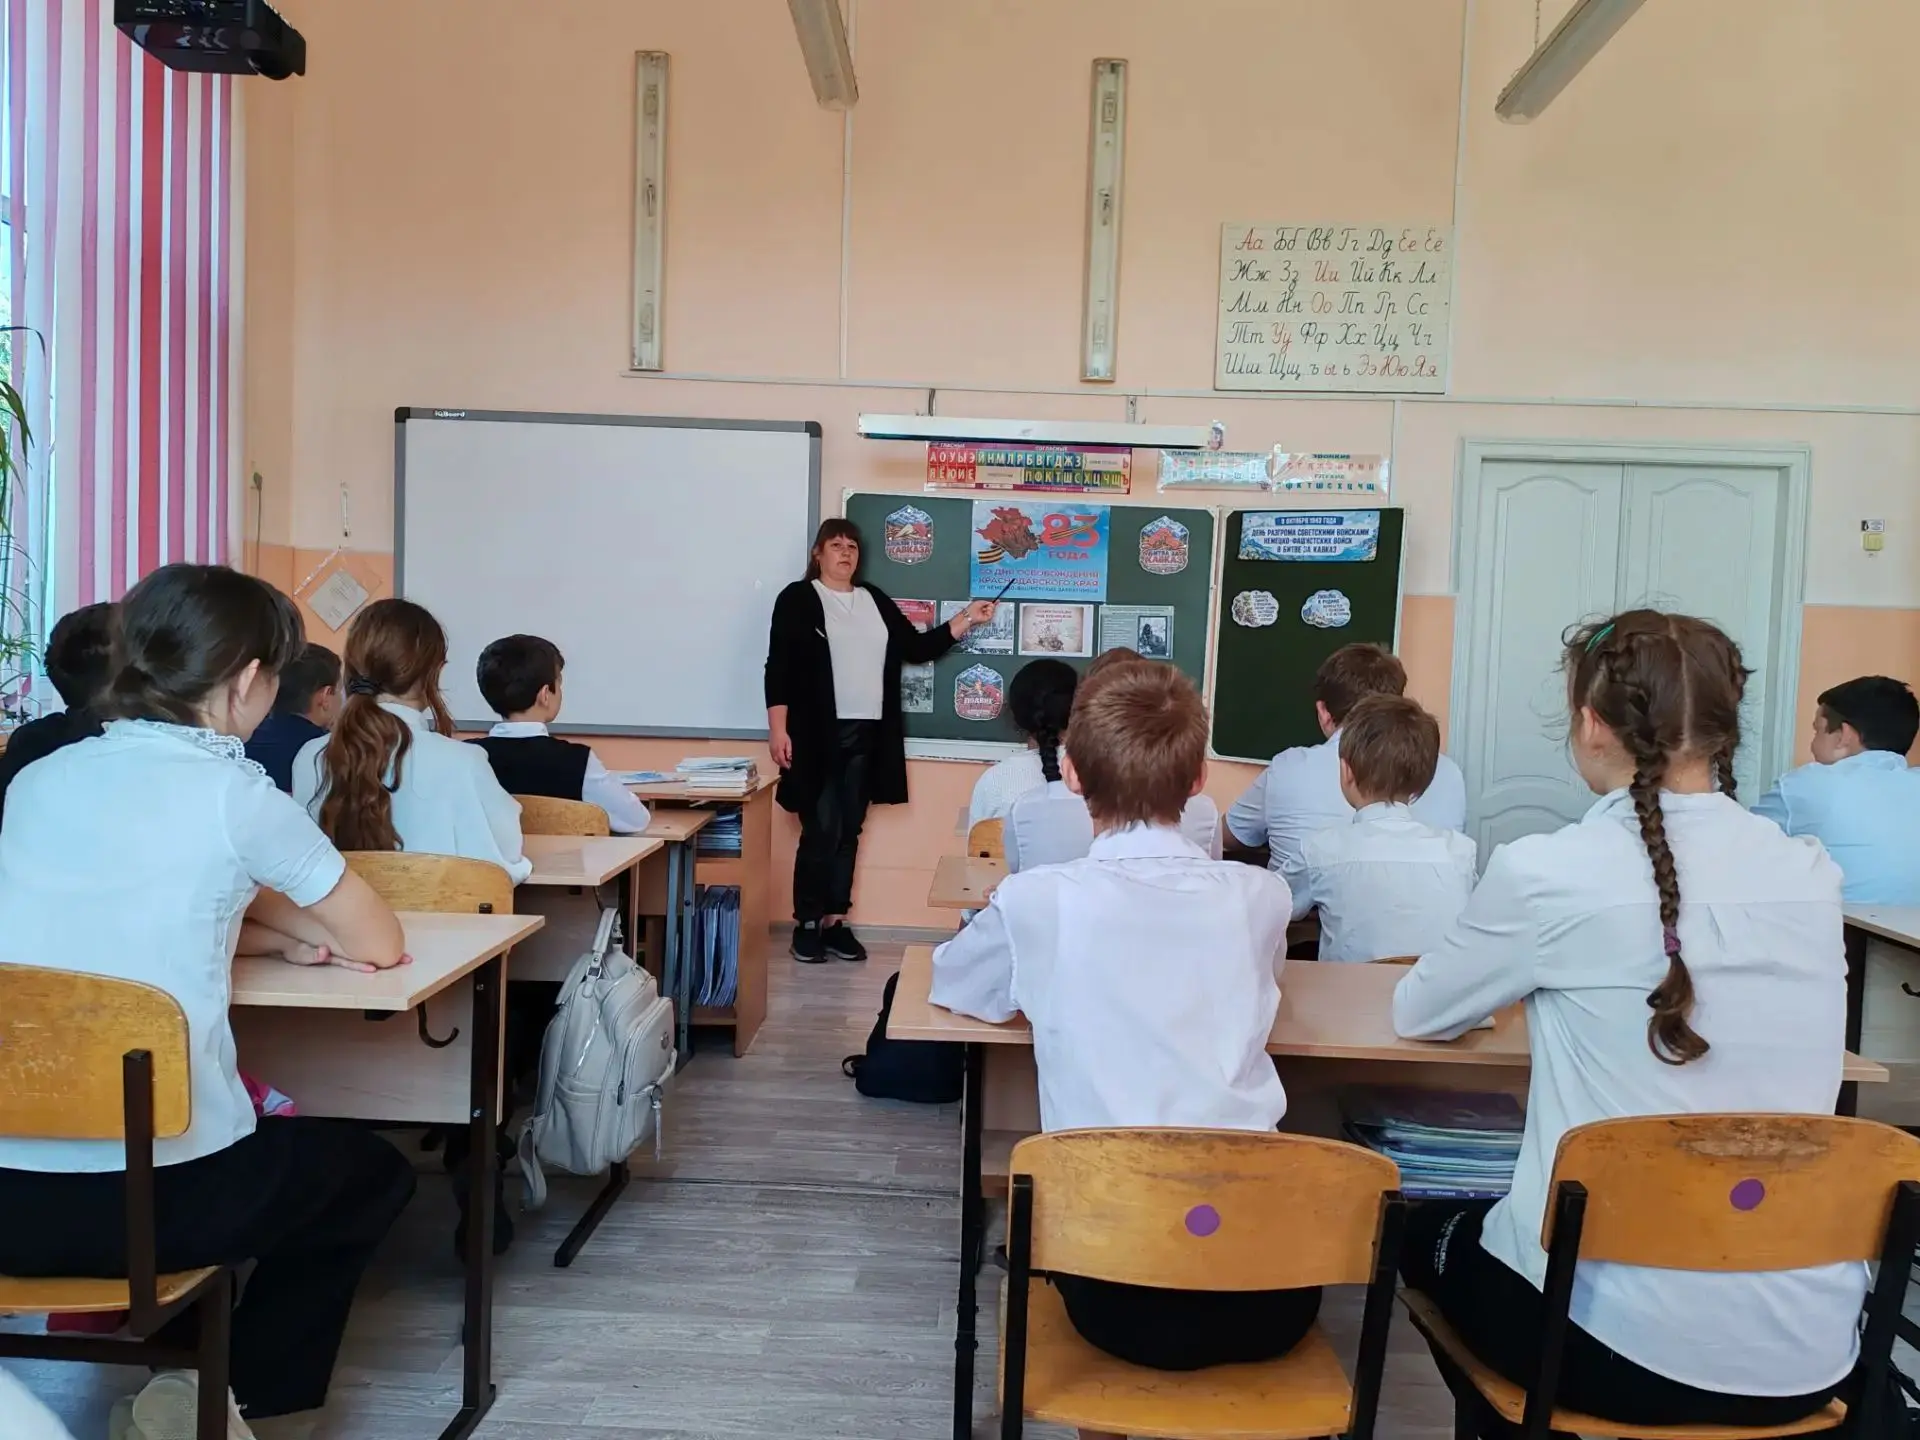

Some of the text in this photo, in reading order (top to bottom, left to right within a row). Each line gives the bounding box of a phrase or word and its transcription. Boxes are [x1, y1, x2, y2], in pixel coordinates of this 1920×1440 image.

[1235, 227, 1264, 250] Аа
[1273, 227, 1306, 250] Бб
[1307, 227, 1334, 250] Вв
[1337, 228, 1360, 251] Гг
[1366, 228, 1393, 259] Дд
[1229, 256, 1436, 292] Жж Зз Ии Йй Кк Лл
[1226, 290, 1428, 322] Мм Нн Оо Пп Рр Сс
[1226, 321, 1432, 354] Тт Уу Фф Хх Цц Чч
[1224, 352, 1262, 374] Шш
[1268, 352, 1301, 380] Щщ
[1356, 354, 1378, 376] Ээ
[1380, 354, 1408, 377] Юю
[1410, 354, 1438, 378] Яя
[1040, 512, 1100, 548] 83
[1298, 528, 1335, 536] СОВЕТСКИМИ
[1336, 528, 1370, 536] ВОЙСКАМИ
[1334, 536, 1352, 544] ВОЙСК
[1048, 550, 1089, 560] ГОДА
